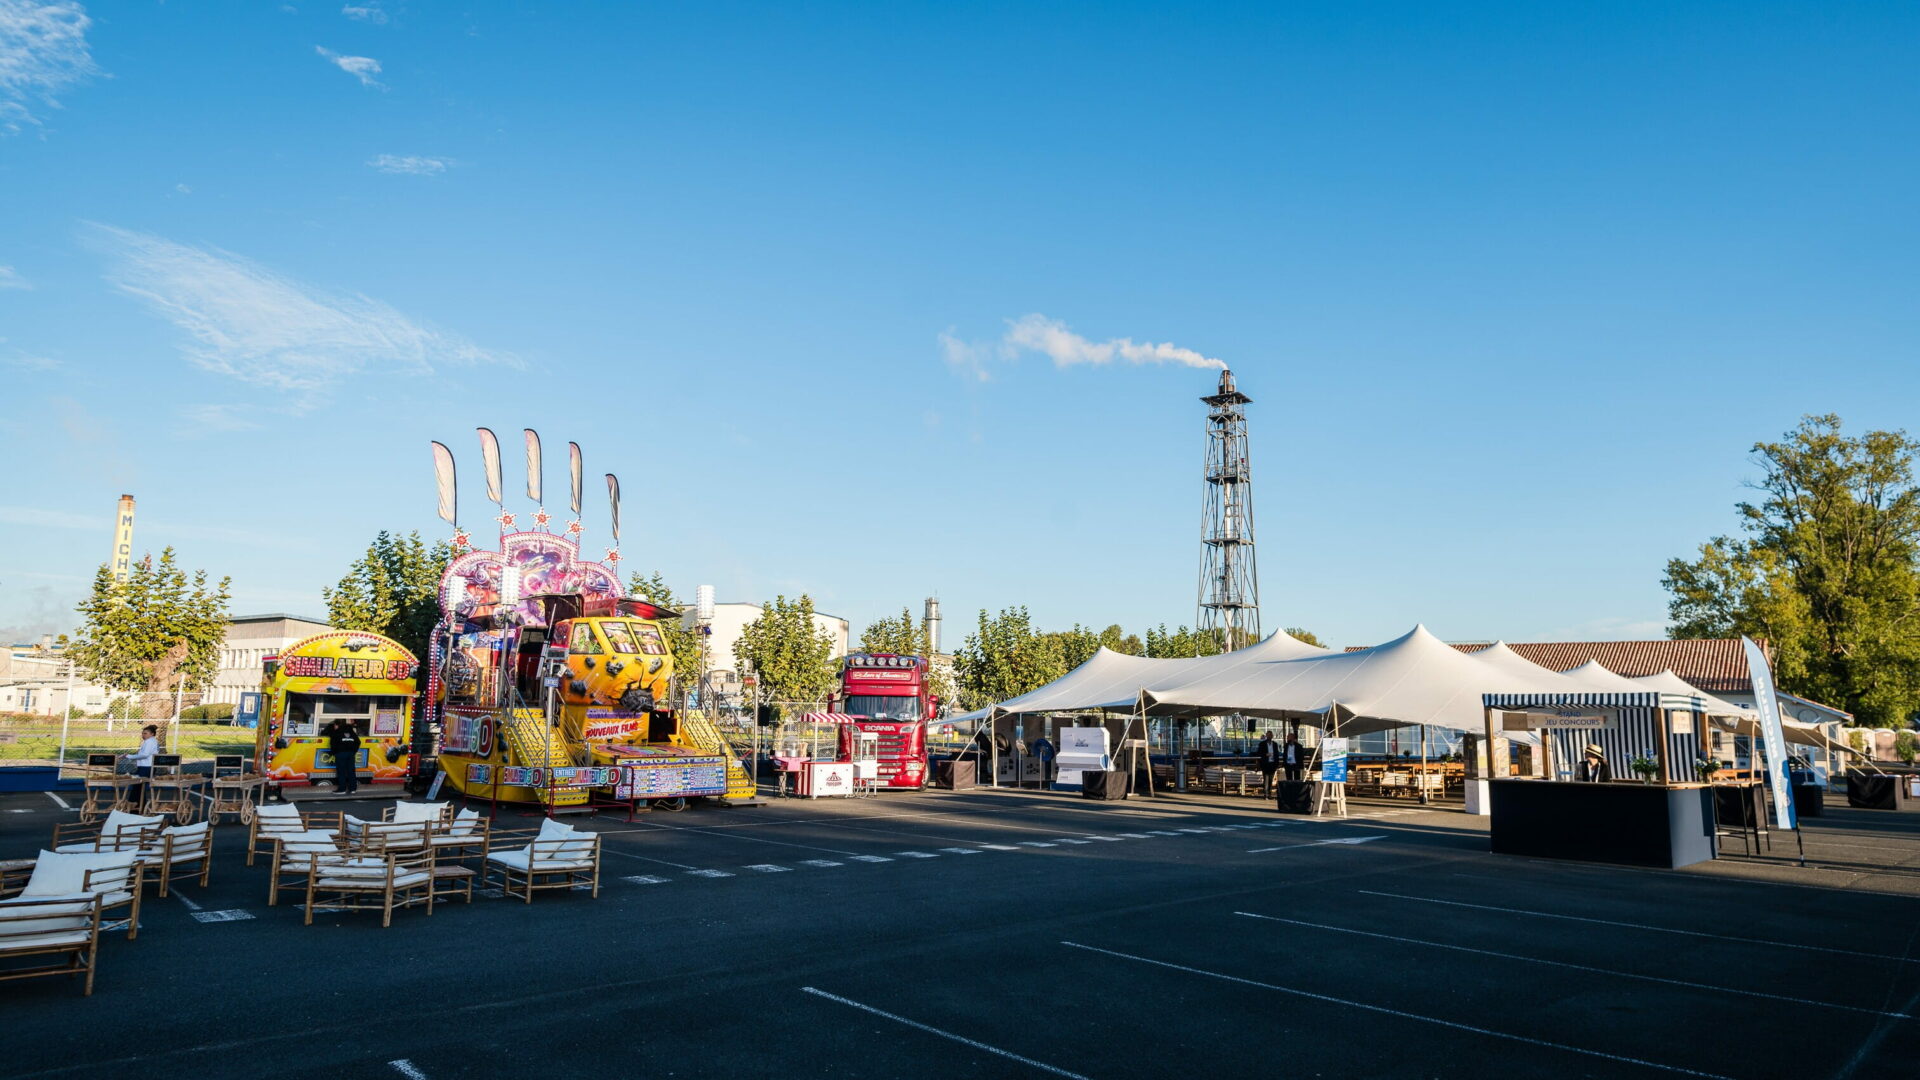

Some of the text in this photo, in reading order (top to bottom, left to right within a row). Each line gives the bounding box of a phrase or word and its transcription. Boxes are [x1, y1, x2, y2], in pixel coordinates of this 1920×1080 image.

[116, 514, 133, 605] MICHE
[284, 655, 411, 681] SIMULATEUR 5D
[585, 721, 639, 740] NOUVEAUX FILMS
[1756, 676, 1779, 760] MICHELIN
[320, 751, 363, 765] CAE
